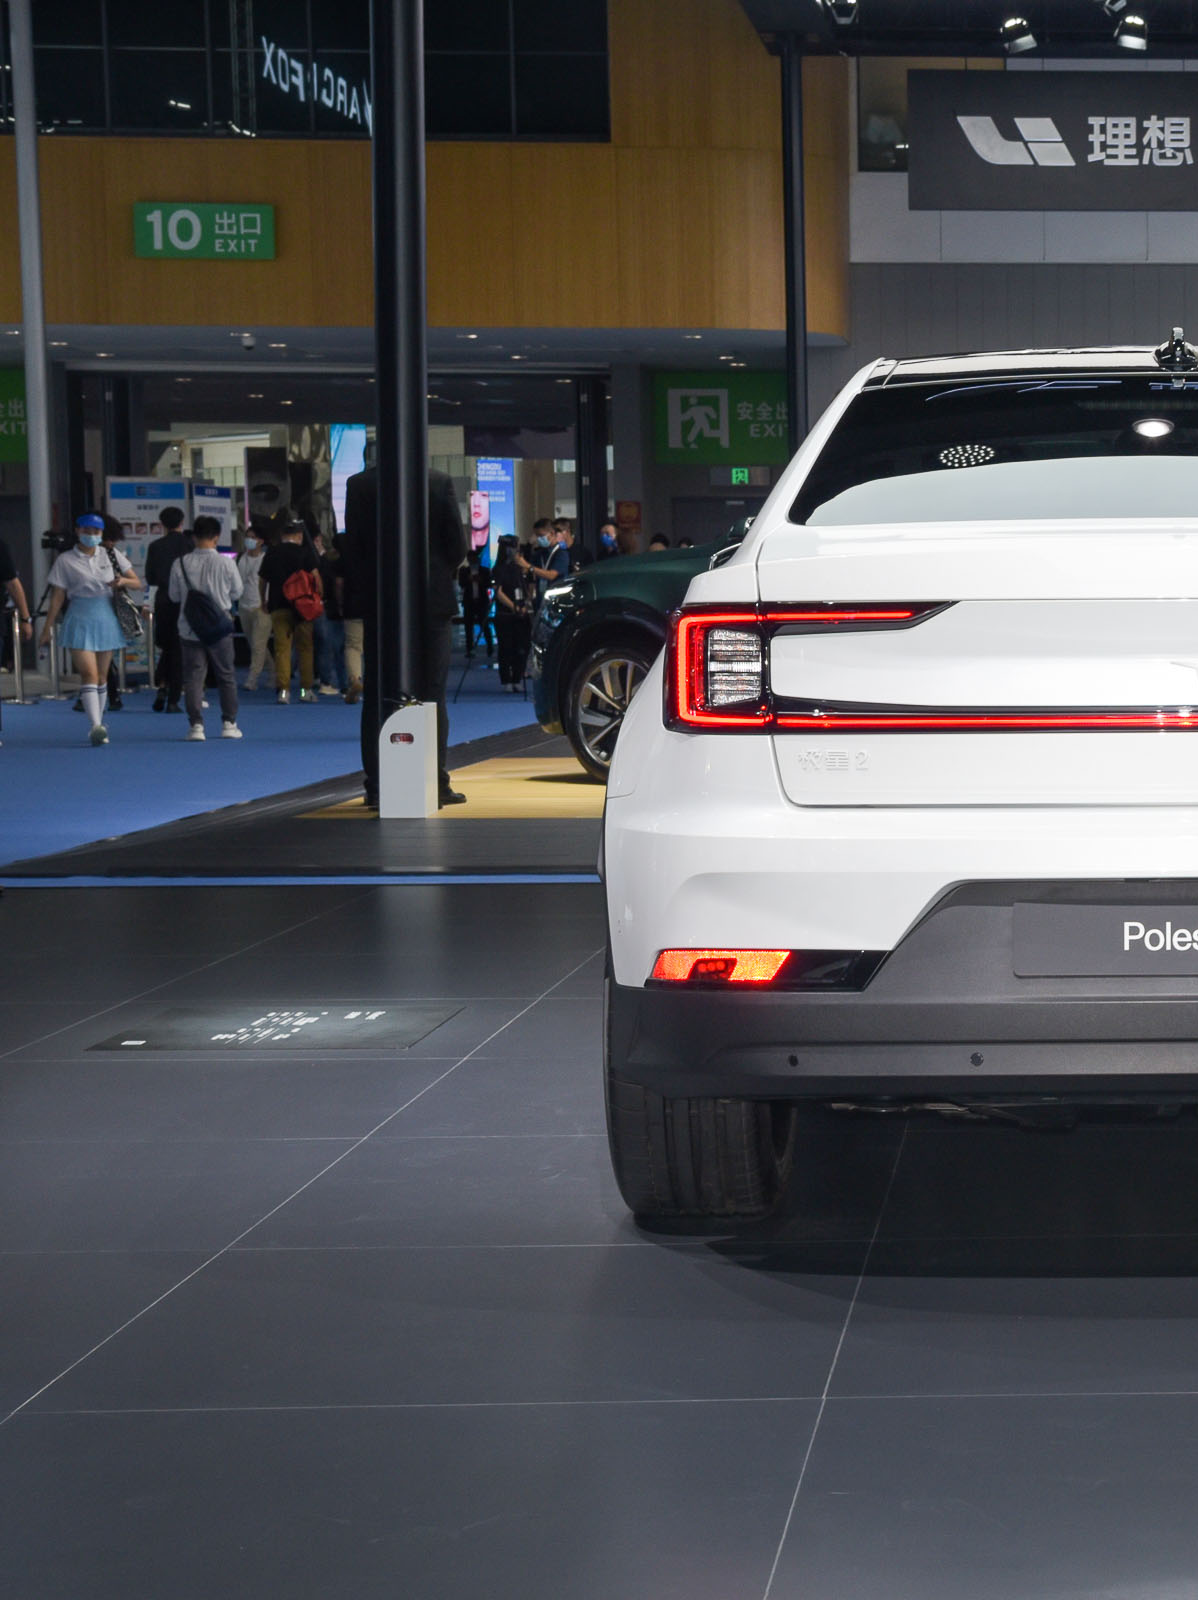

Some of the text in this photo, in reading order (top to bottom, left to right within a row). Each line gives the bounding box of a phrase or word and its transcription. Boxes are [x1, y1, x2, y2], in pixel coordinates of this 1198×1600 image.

[1087, 114, 1194, 167] 理想
[146, 208, 203, 251] 10
[214, 210, 262, 235] 出口
[214, 238, 258, 253] EXIT
[749, 423, 788, 438] EXI
[855, 750, 869, 771] 2
